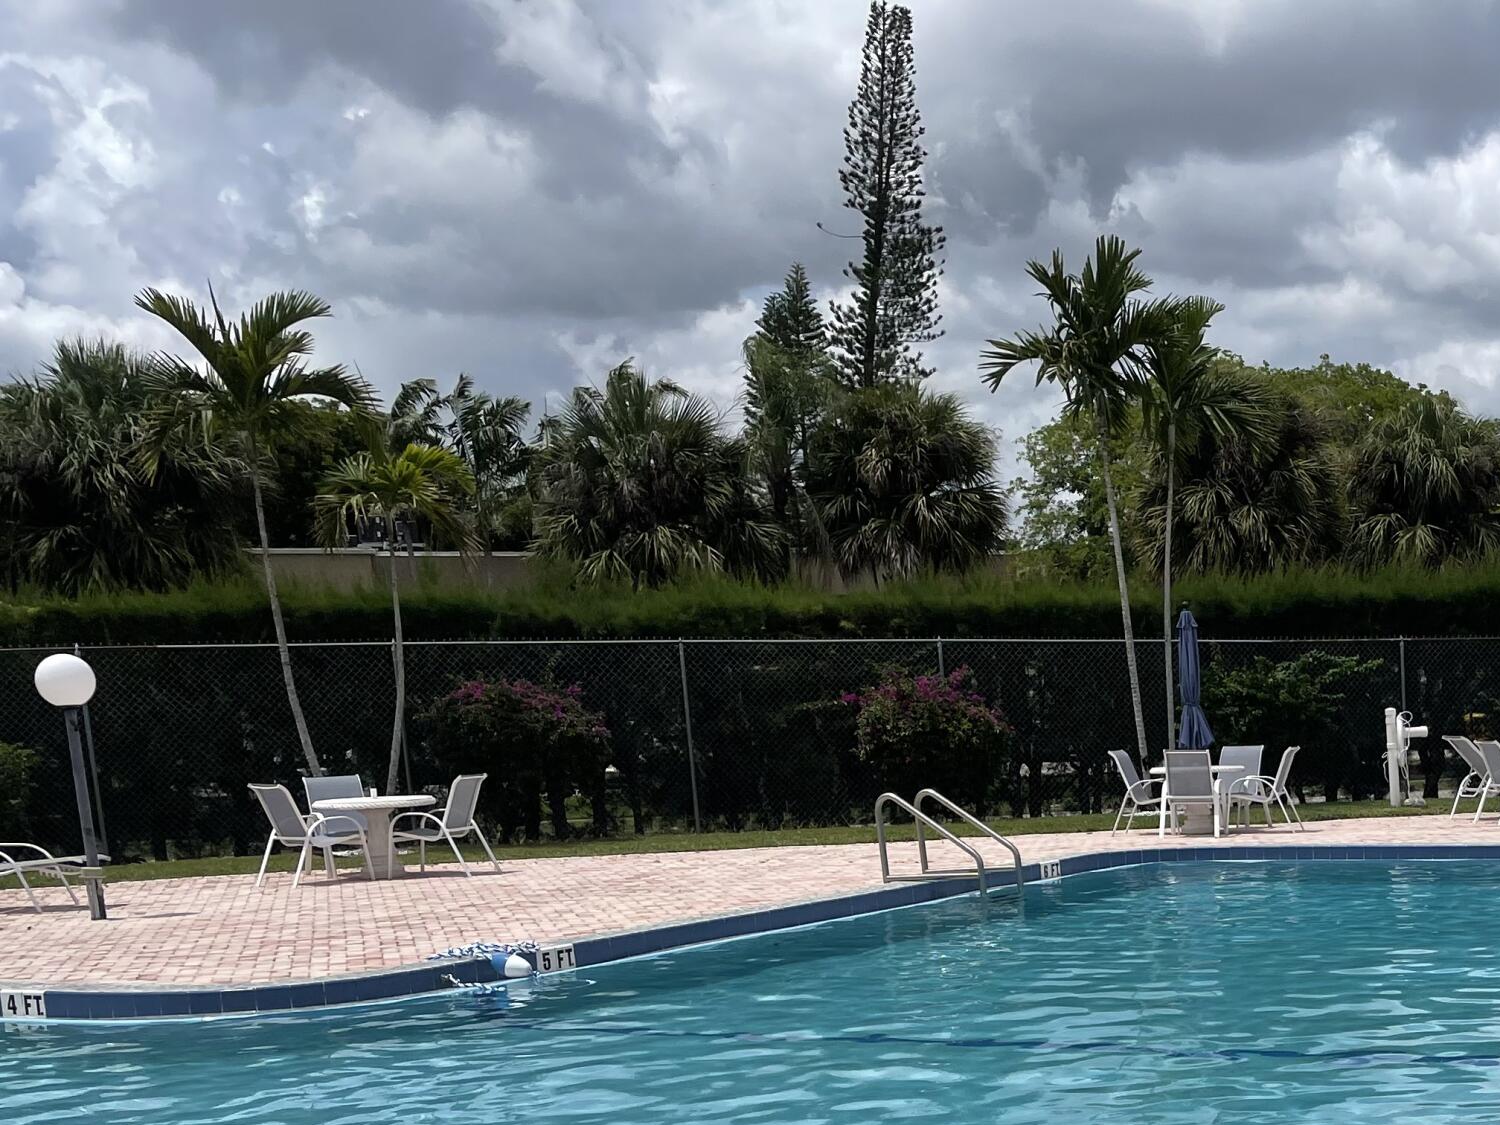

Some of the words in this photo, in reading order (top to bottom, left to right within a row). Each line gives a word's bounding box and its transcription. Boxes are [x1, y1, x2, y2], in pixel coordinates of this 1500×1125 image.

[1043, 865, 1049, 878] 6
[542, 952, 552, 971] 5
[7, 994, 17, 1015] 4
